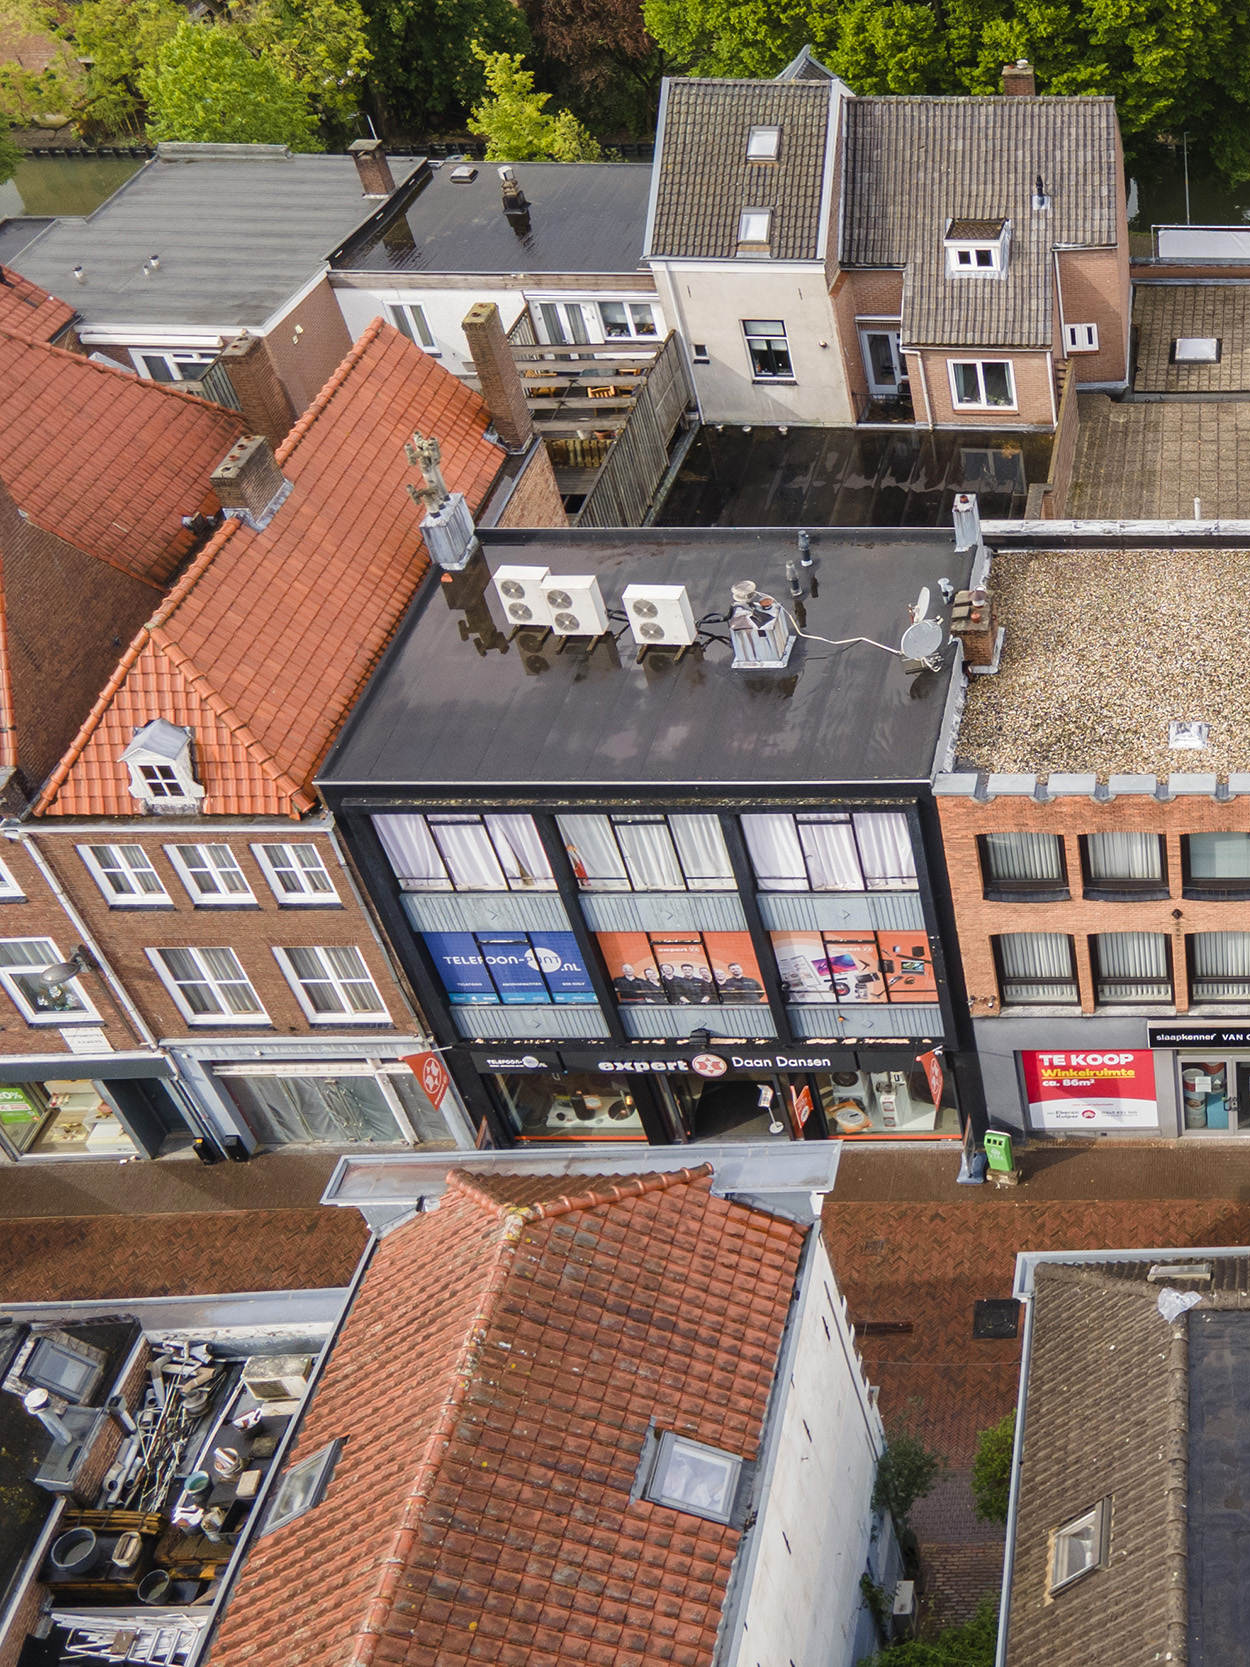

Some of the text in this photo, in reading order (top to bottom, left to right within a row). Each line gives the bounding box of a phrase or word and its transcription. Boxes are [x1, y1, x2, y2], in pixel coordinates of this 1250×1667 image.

[1156, 1033, 1215, 1042] slaapkenner
[1222, 1033, 1243, 1041] VAN
[731, 1056, 831, 1067] Daan Dansen
[1039, 1053, 1134, 1066] TE KOOP
[598, 1060, 689, 1072] expert
[1041, 1068, 1135, 1078] Winkelruimte
